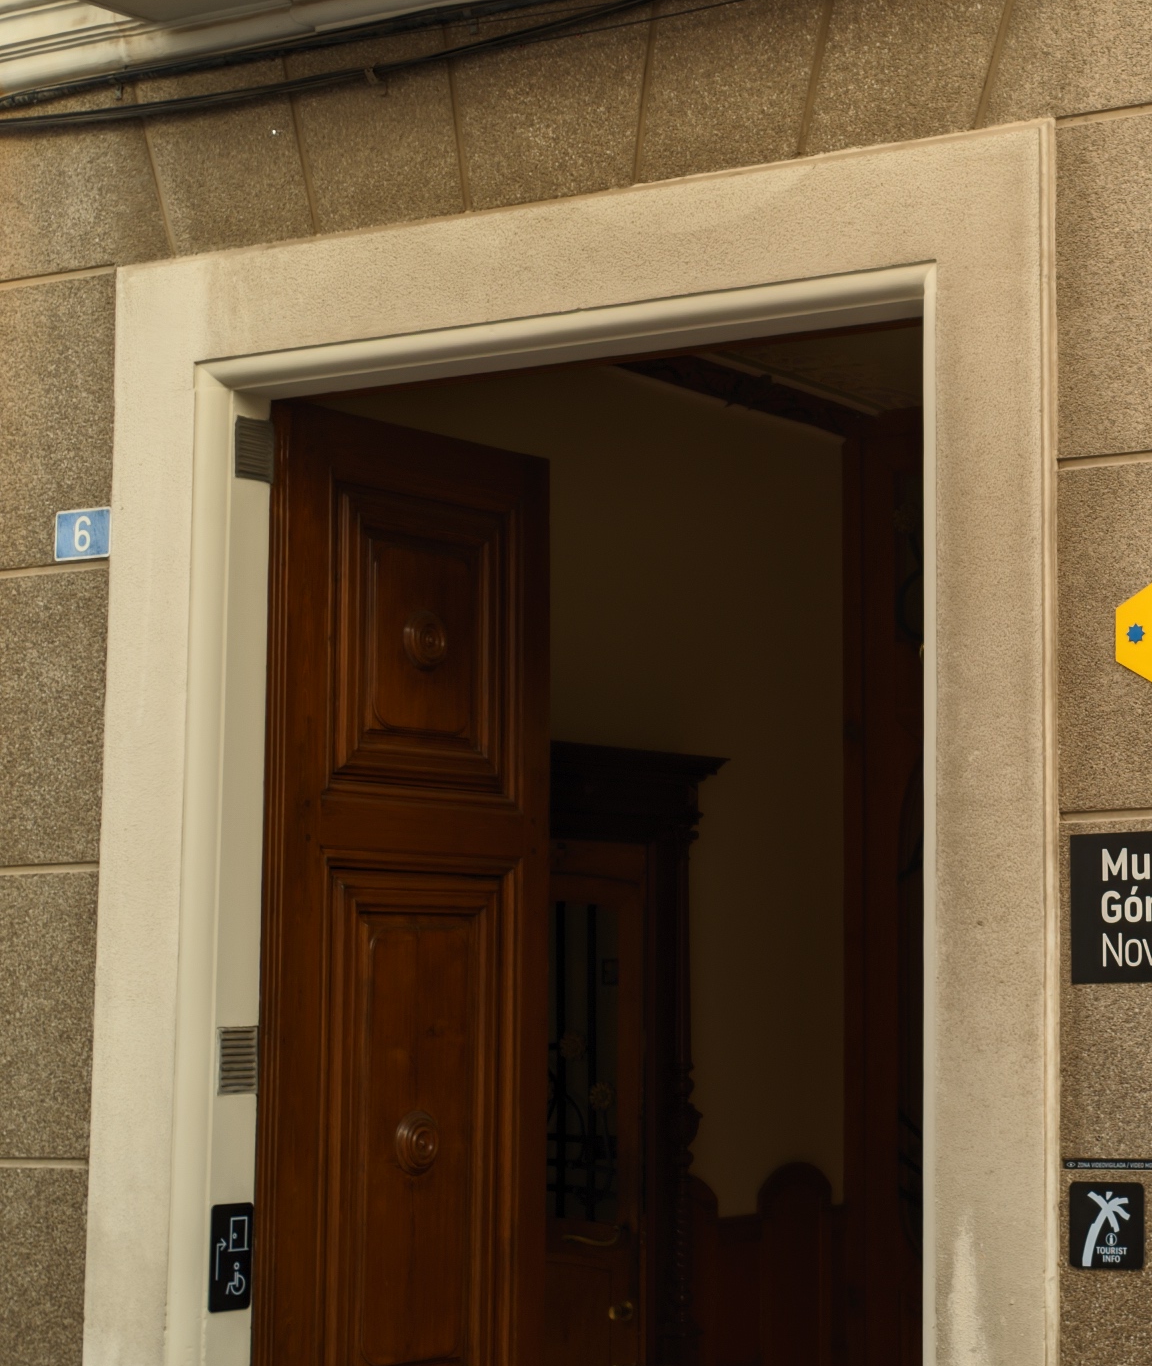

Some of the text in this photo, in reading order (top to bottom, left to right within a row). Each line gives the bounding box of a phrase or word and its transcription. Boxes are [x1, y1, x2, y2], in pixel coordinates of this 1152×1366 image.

[74, 515, 91, 552] 6
[1096, 1246, 1127, 1255] TOURIST
[1102, 1255, 1121, 1263] INFO
